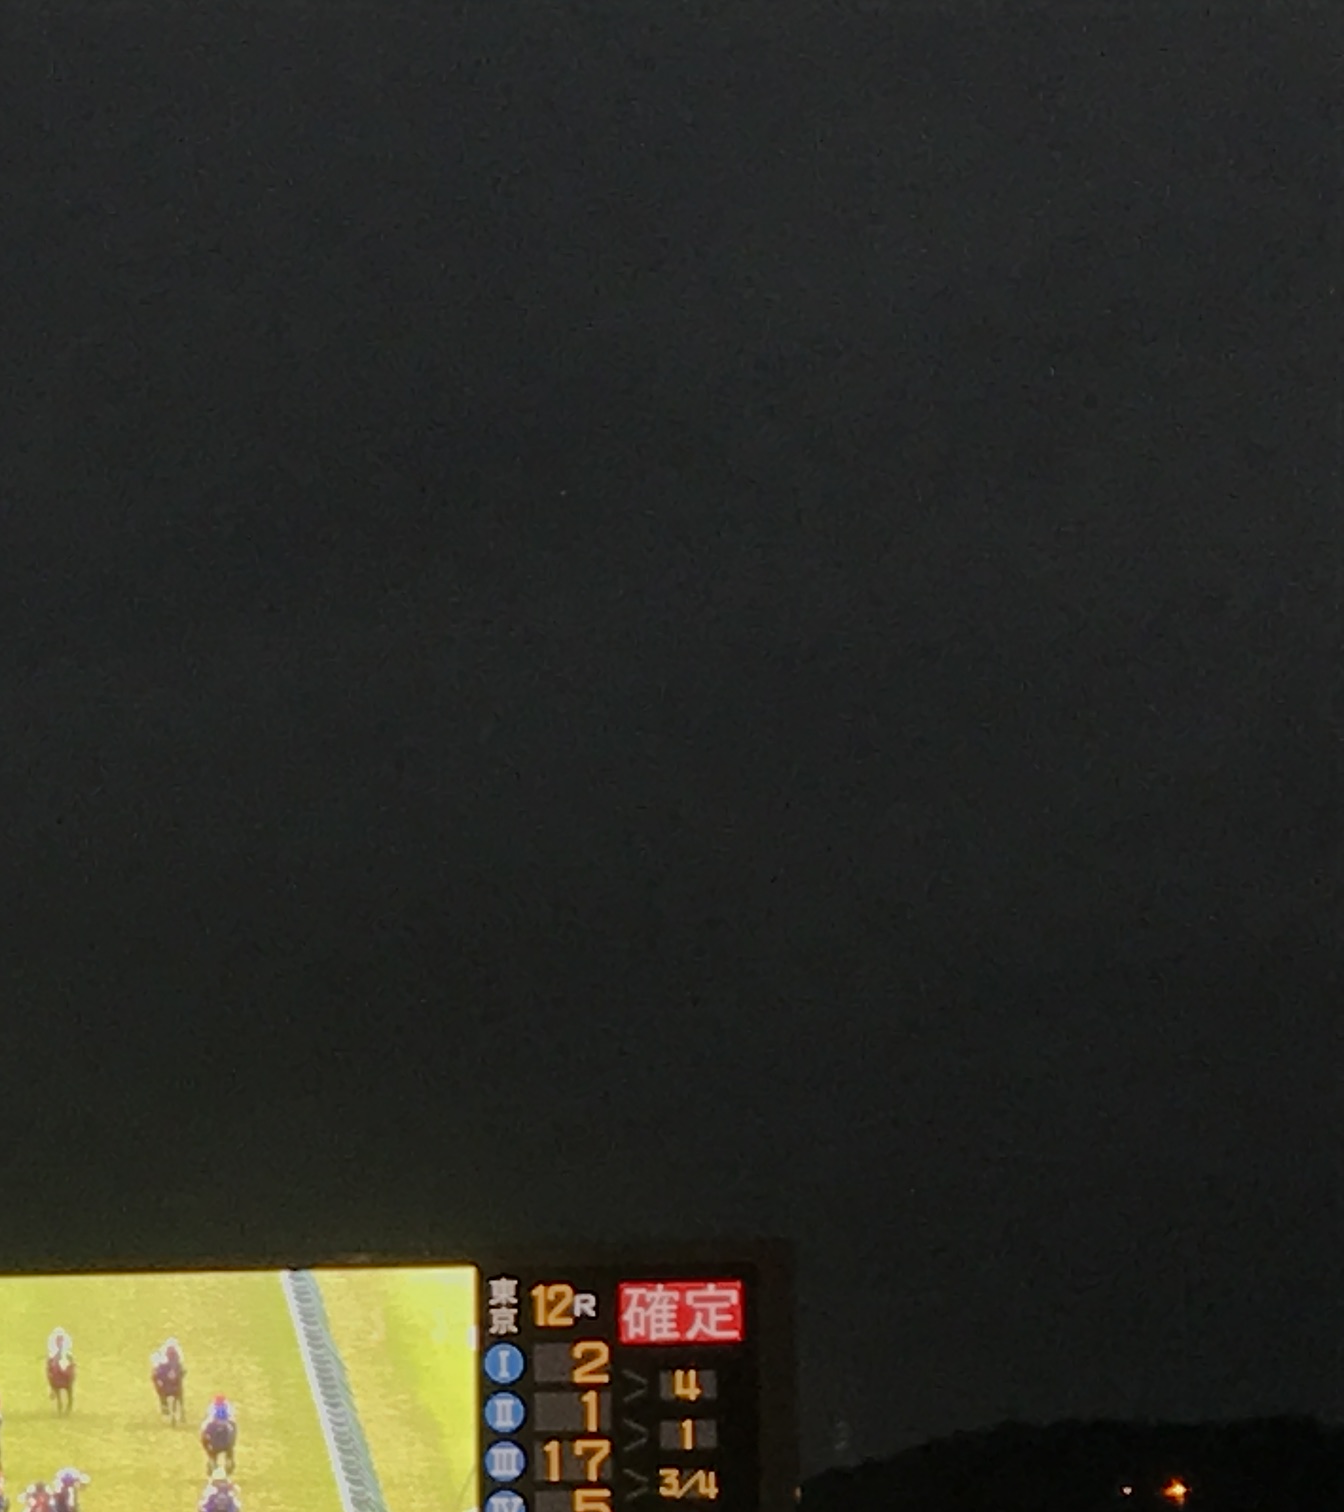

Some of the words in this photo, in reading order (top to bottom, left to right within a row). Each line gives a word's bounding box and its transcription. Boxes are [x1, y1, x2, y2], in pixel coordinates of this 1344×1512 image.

[488, 1277, 519, 1335] 東京
[622, 1282, 742, 1342] 確定
[571, 1340, 611, 1384] 2
[673, 1368, 702, 1402] 4
[581, 1390, 600, 1433] 1
[681, 1418, 695, 1452] 1
[543, 1439, 612, 1484] 17
[658, 1467, 719, 1500] 3/4
